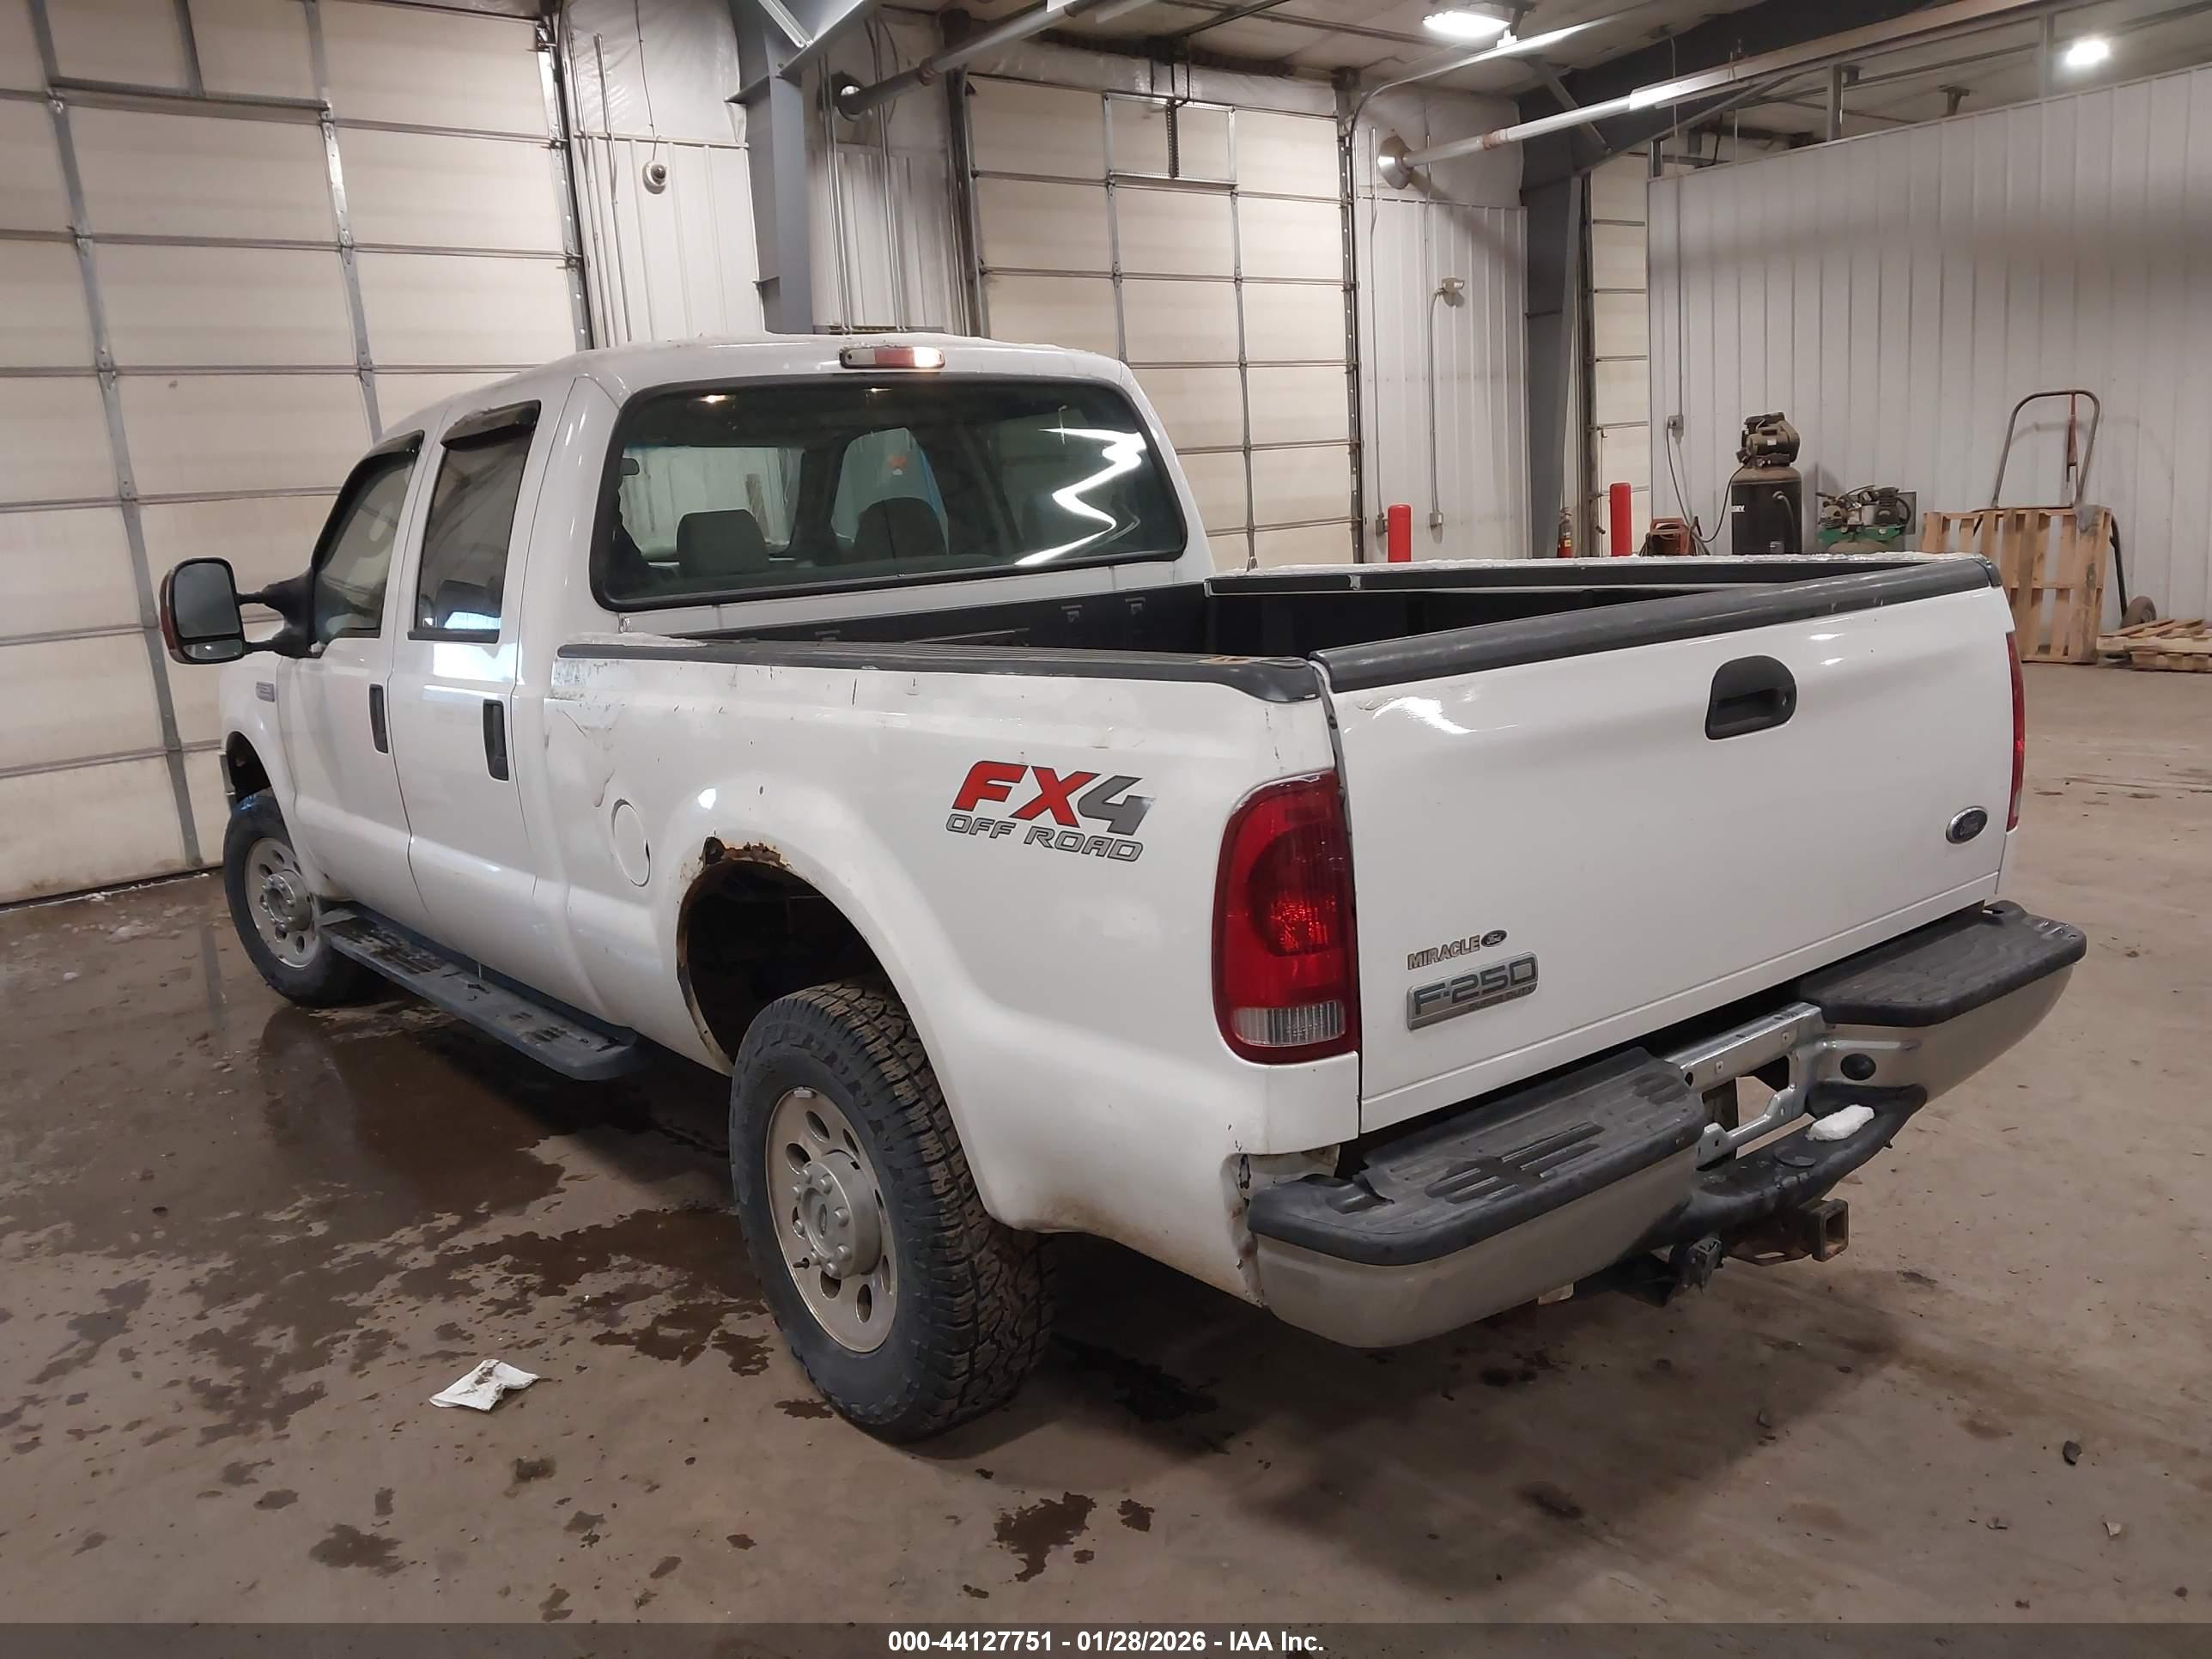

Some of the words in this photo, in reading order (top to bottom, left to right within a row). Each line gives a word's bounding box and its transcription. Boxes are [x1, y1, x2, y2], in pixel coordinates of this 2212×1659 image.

[951, 761, 1156, 836] FX4
[945, 813, 1017, 838] OFF
[1024, 825, 1143, 862] ROAD
[1407, 934, 1480, 969] MIRACLE
[1414, 957, 1537, 1015] F-250
